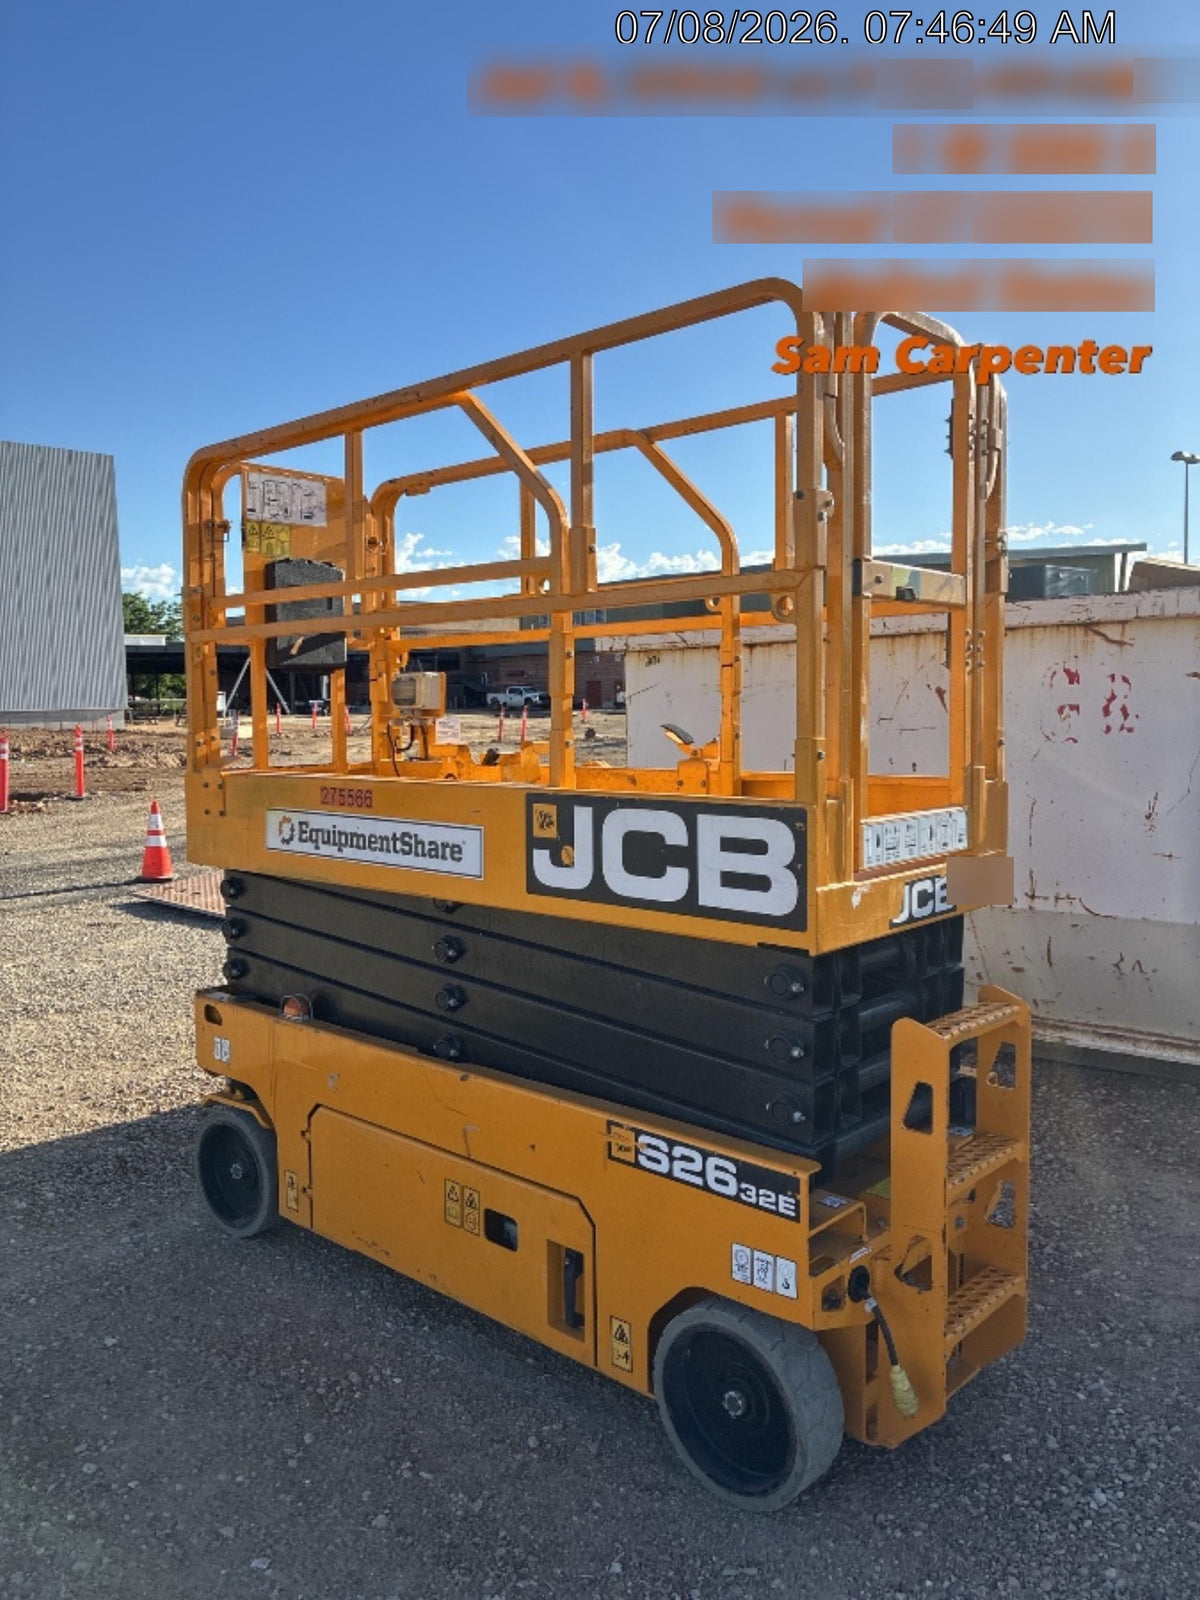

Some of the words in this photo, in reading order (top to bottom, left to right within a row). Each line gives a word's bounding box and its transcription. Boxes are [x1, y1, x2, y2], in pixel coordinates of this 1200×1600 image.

[320, 787, 373, 808] 275566
[297, 820, 464, 863] EquipmentShare
[532, 804, 799, 917] JCB
